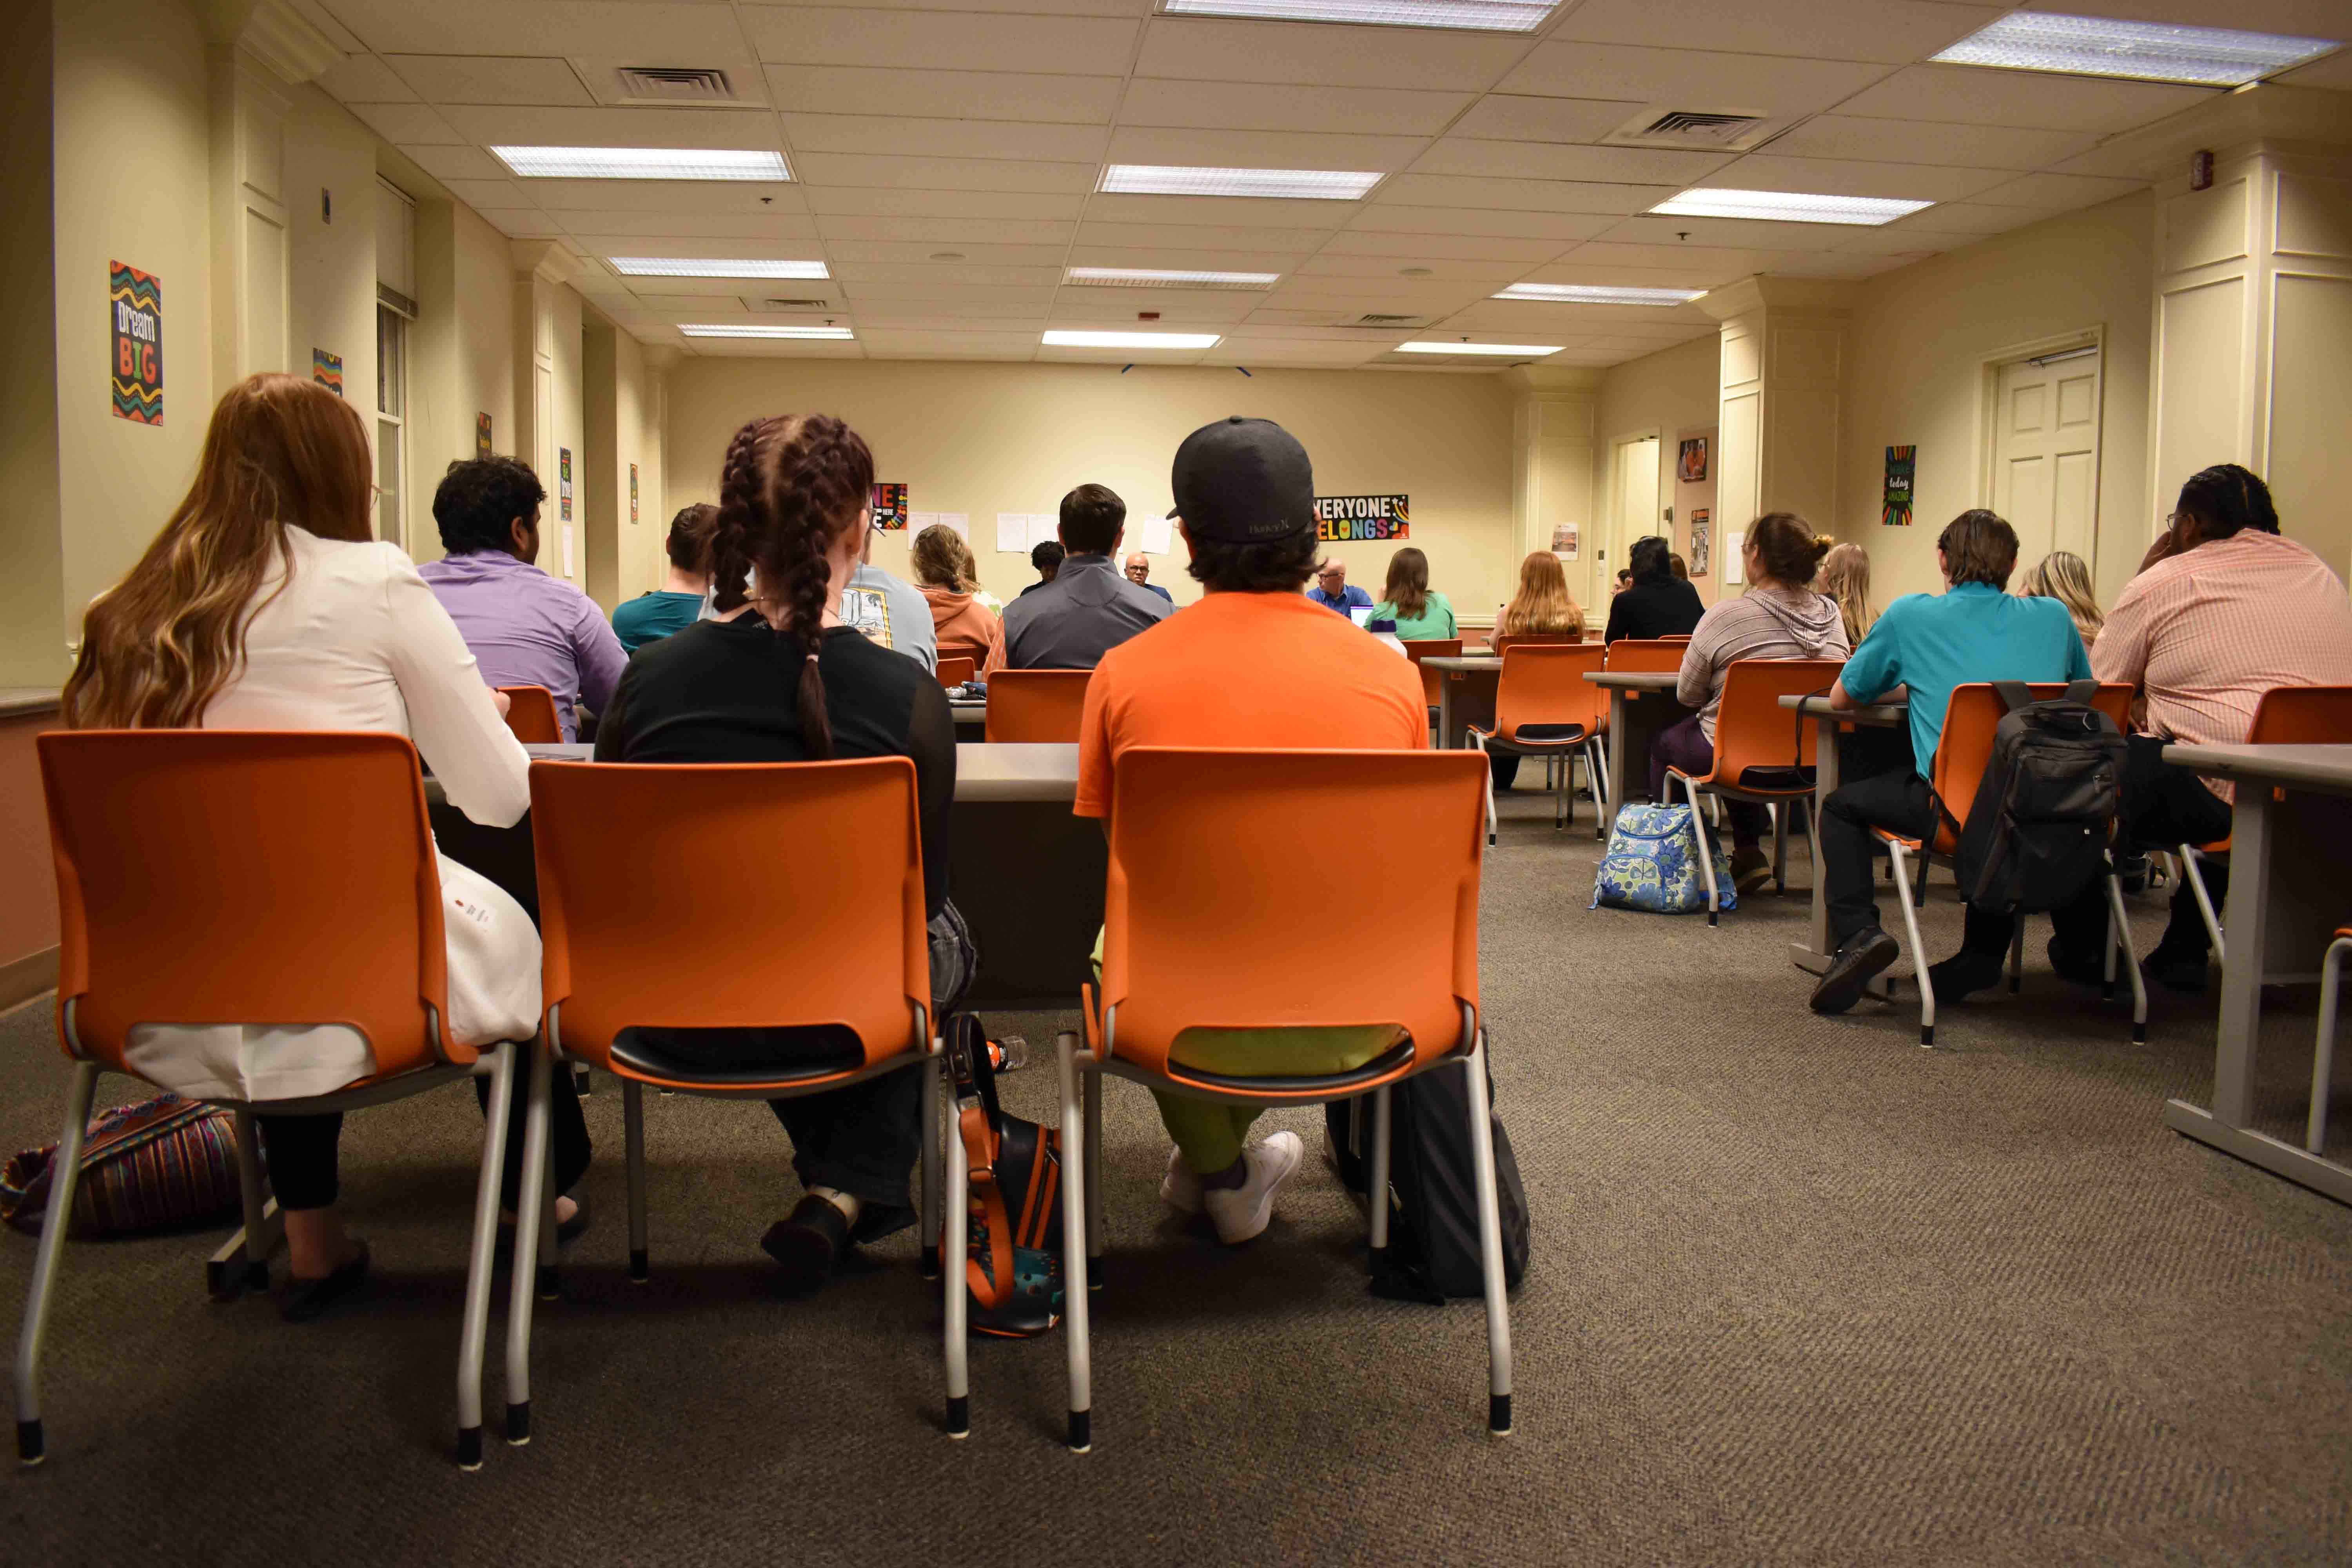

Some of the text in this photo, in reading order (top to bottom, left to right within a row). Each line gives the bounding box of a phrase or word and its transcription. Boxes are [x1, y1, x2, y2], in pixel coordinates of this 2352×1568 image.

[118, 301, 155, 342] Dream
[119, 336, 156, 384] BIG
[1890, 476, 1909, 490] today
[1314, 497, 1391, 519] ERYONE
[1317, 519, 1388, 540] ELONGS
